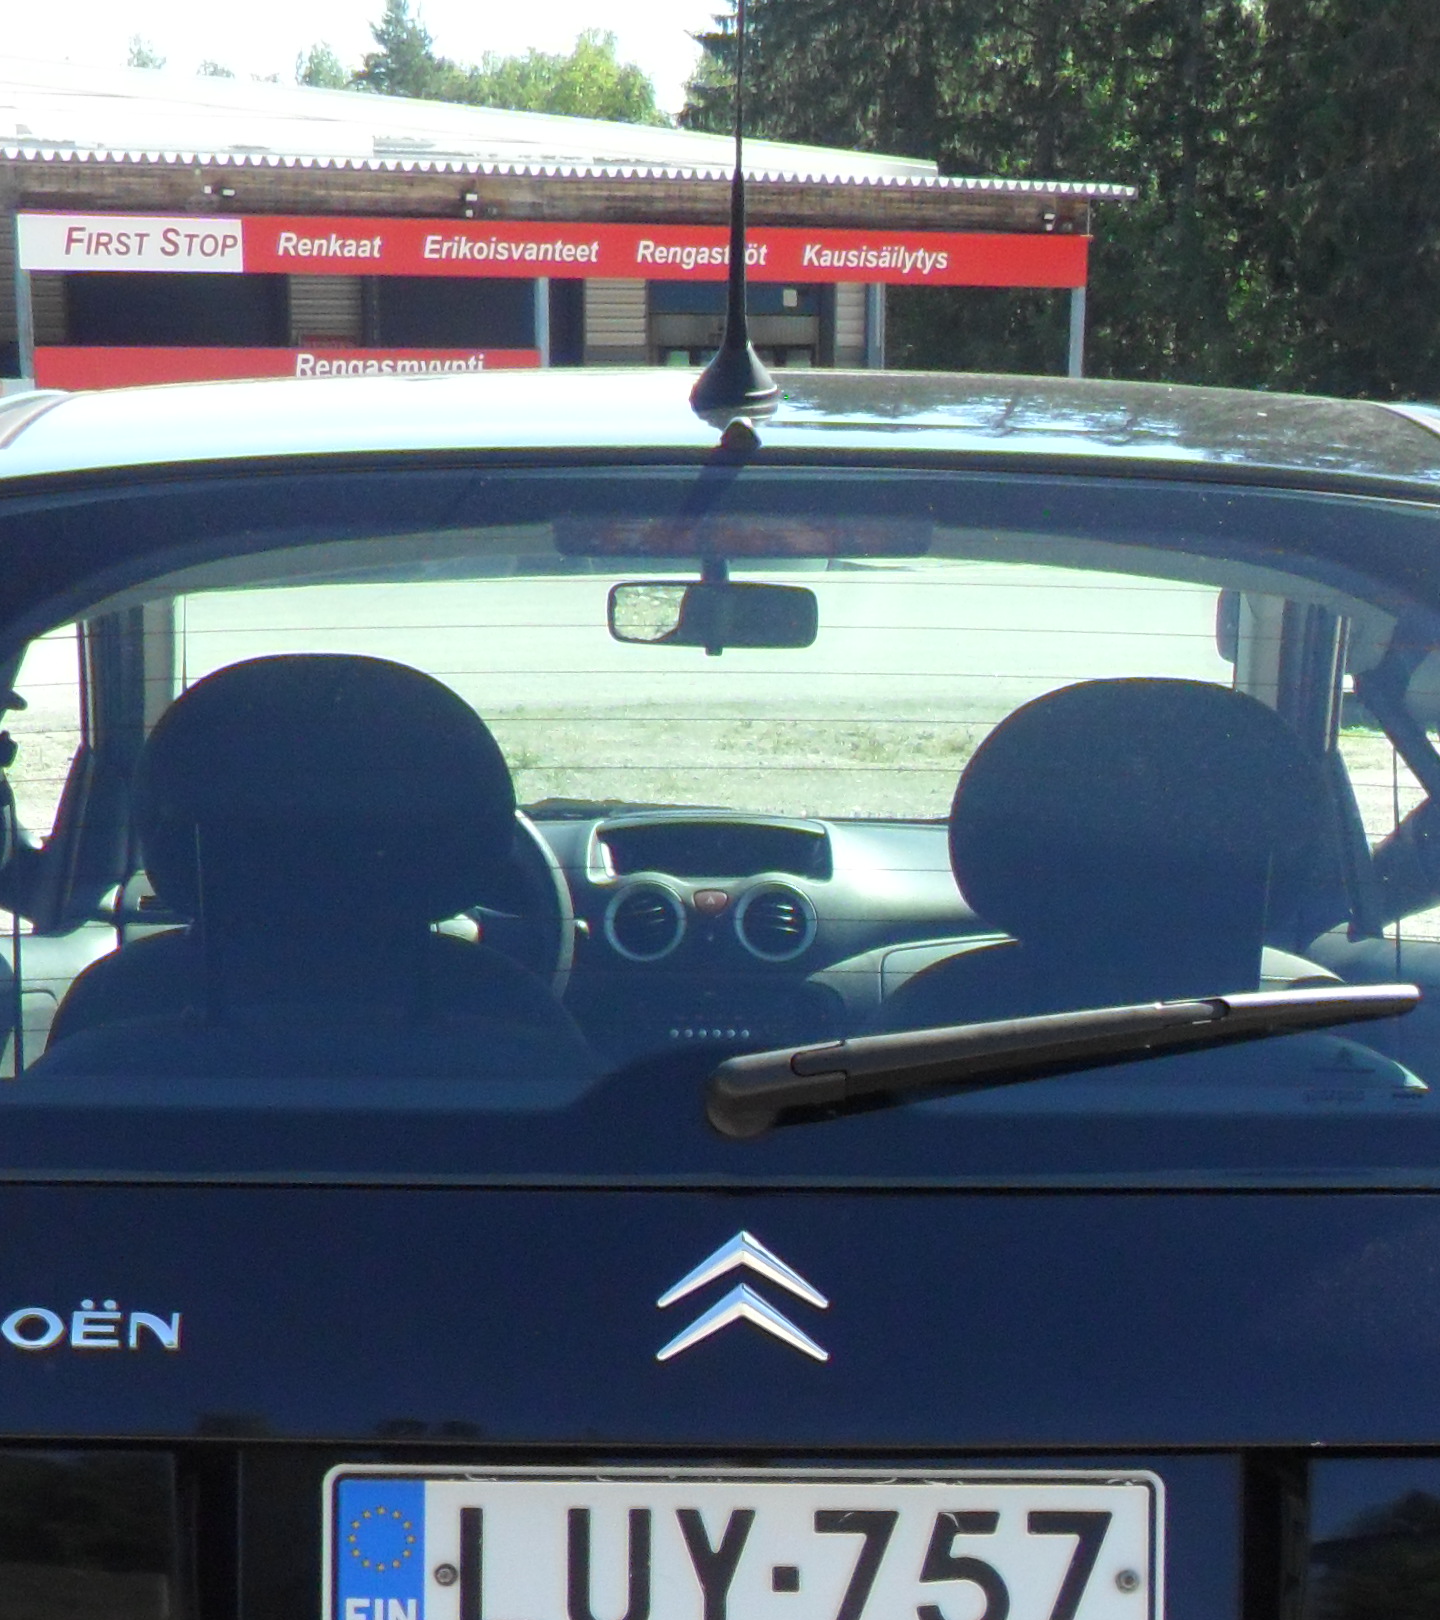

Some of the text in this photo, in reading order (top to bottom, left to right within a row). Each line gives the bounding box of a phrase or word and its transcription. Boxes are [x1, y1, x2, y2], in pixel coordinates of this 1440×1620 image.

[64, 225, 239, 258] FIRST STOP
[277, 231, 382, 259] Renkaat
[423, 234, 599, 264] Erikoisvanteet
[636, 239, 768, 270] Rengastöt
[802, 243, 949, 275] Kausisäilytys
